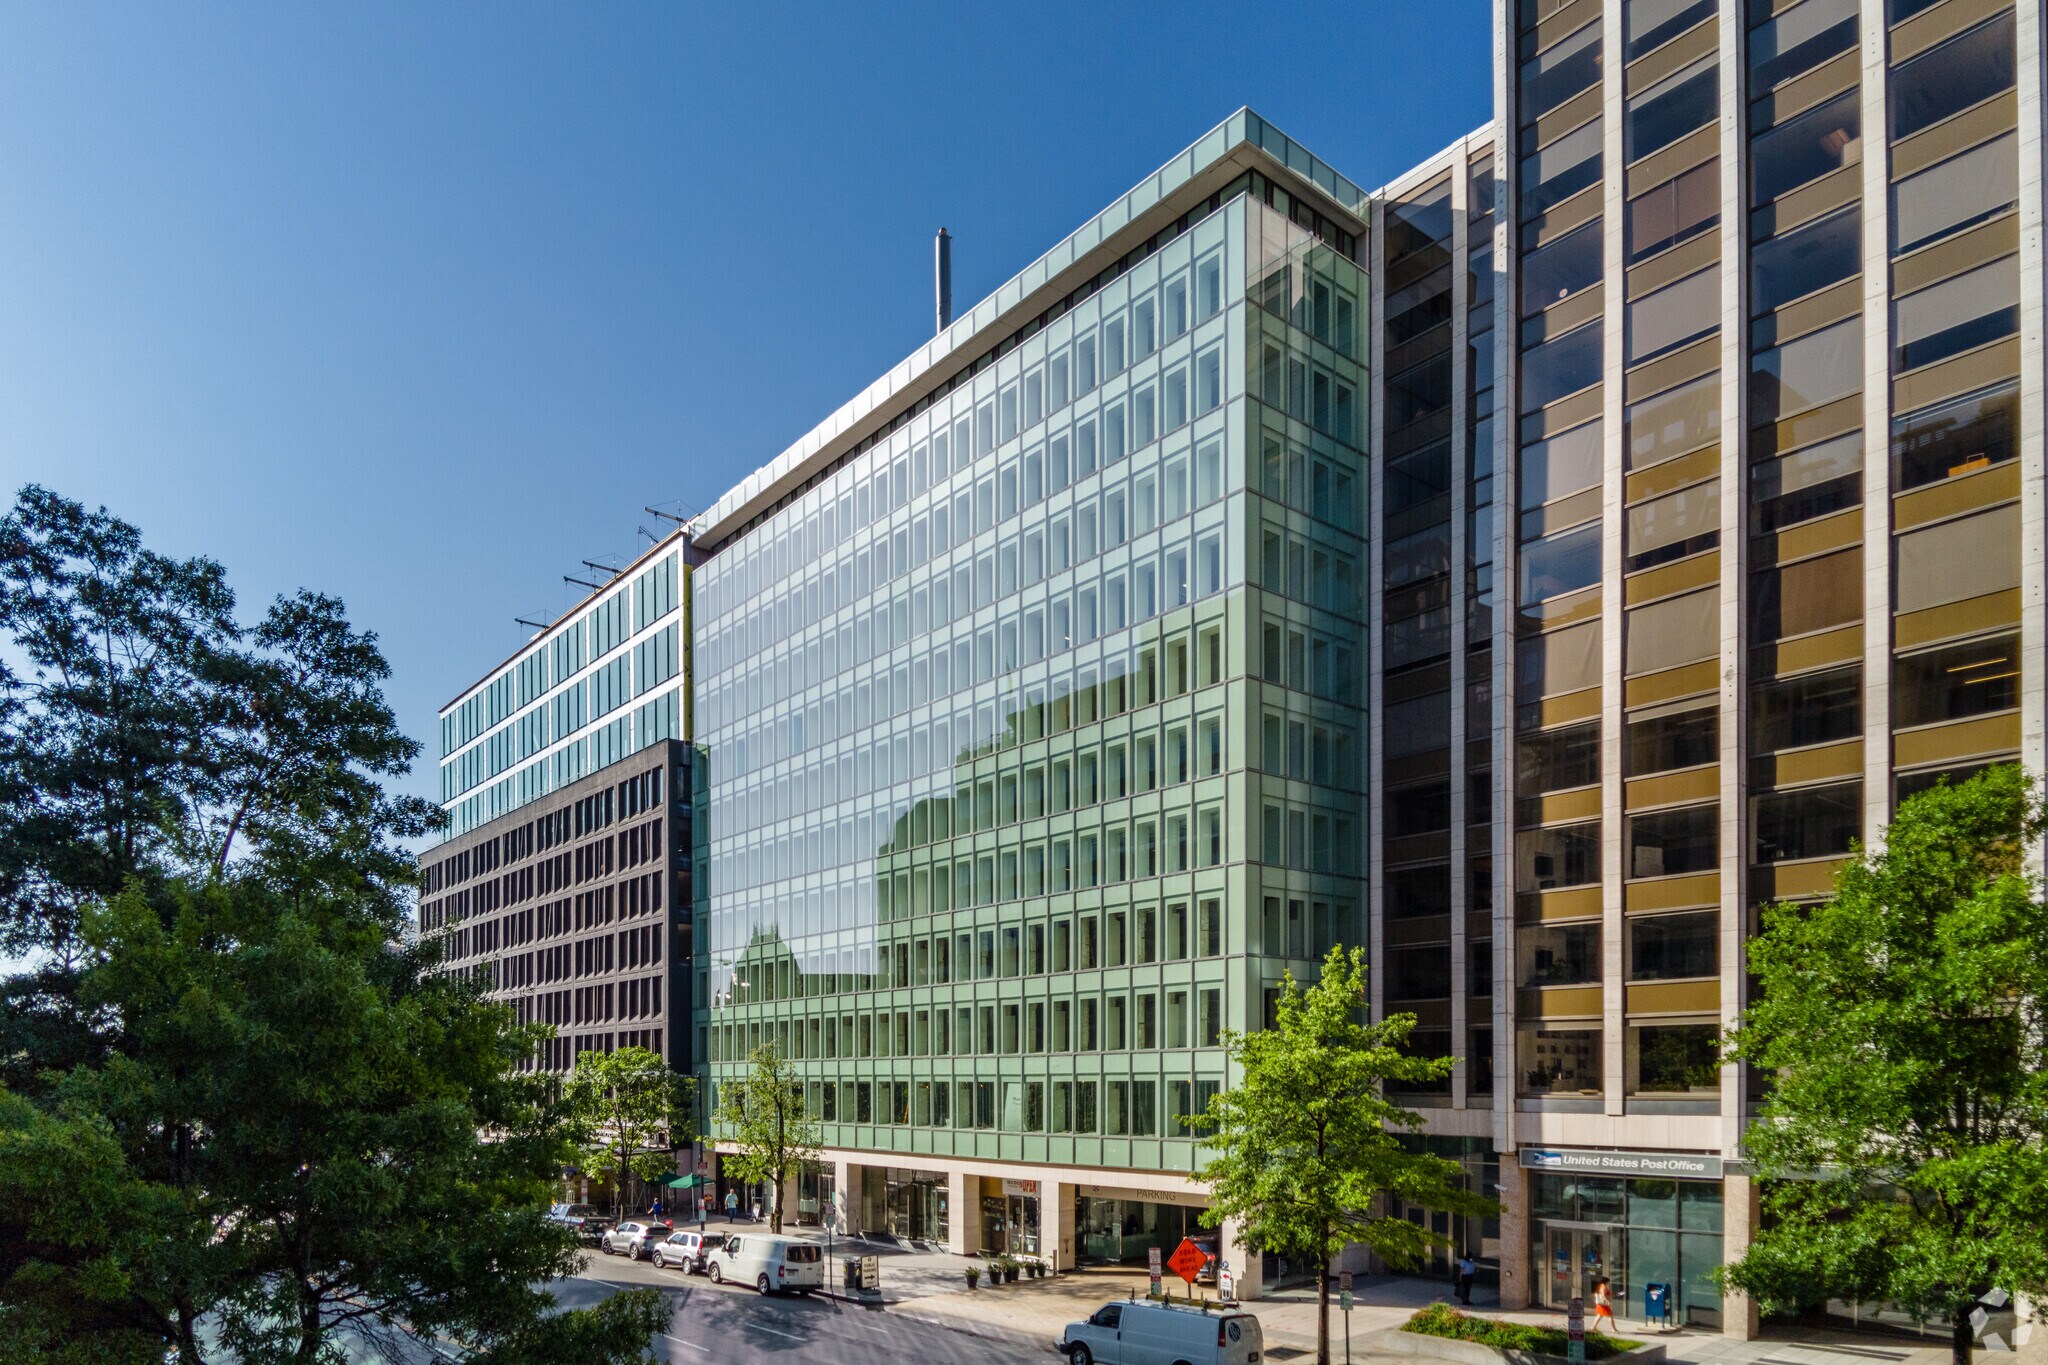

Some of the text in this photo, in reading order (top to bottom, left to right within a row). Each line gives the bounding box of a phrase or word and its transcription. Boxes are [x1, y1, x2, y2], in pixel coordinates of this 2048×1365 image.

[1563, 1155, 1705, 1171] United States Post Office
[1022, 1180, 1037, 1193] OPEN
[1136, 1189, 1176, 1201] PARKING
[1180, 1265, 1199, 1273] AHEAD
